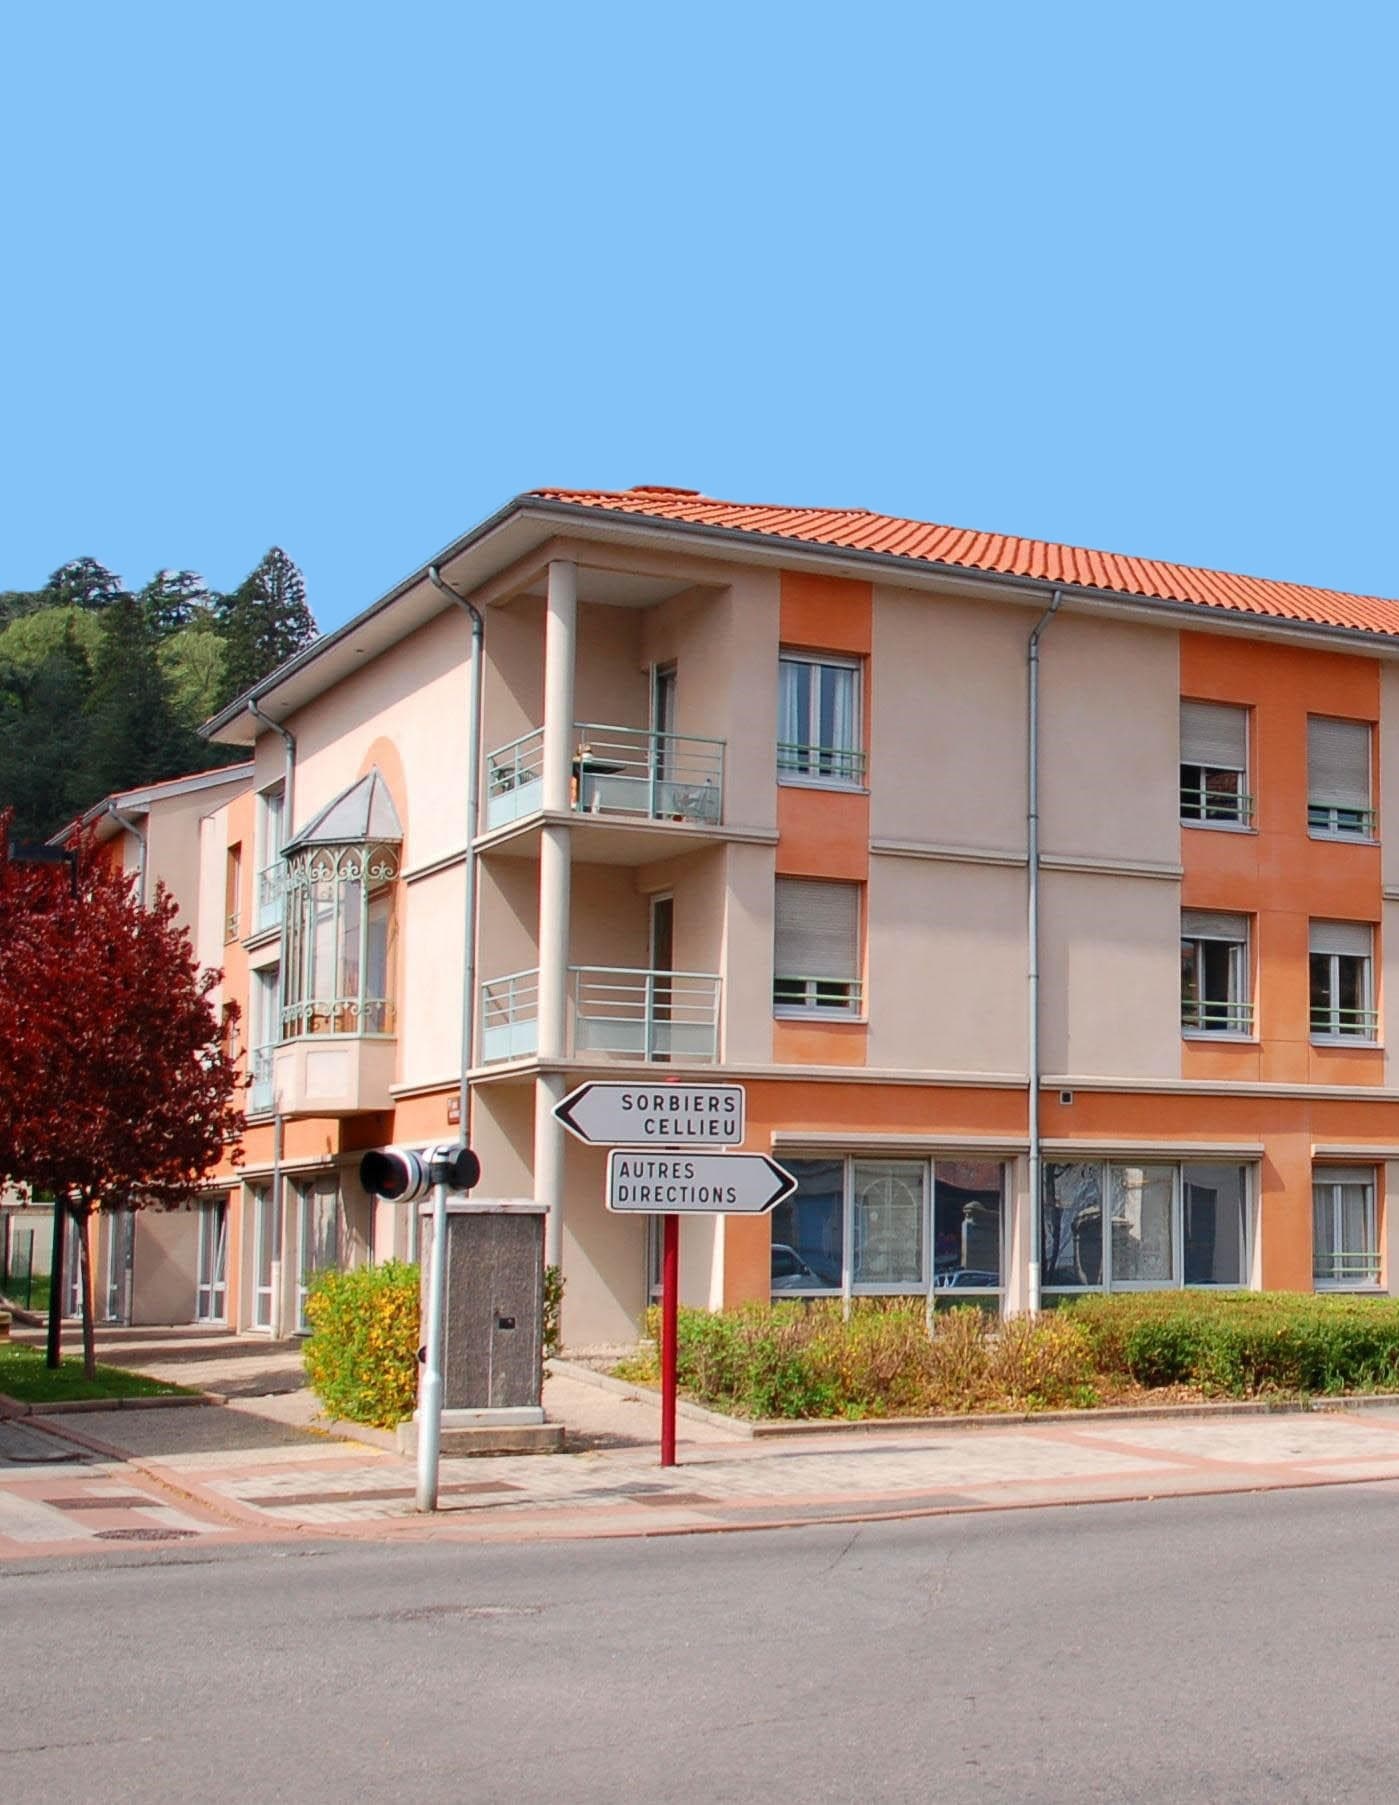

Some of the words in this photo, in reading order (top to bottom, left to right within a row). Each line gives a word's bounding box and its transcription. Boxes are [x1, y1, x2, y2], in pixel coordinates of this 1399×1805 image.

[622, 1094, 735, 1112] SORBIERS
[644, 1118, 735, 1136] CELLIEU
[619, 1161, 694, 1179] AUTRES
[618, 1185, 736, 1203] DIRECTIONS
